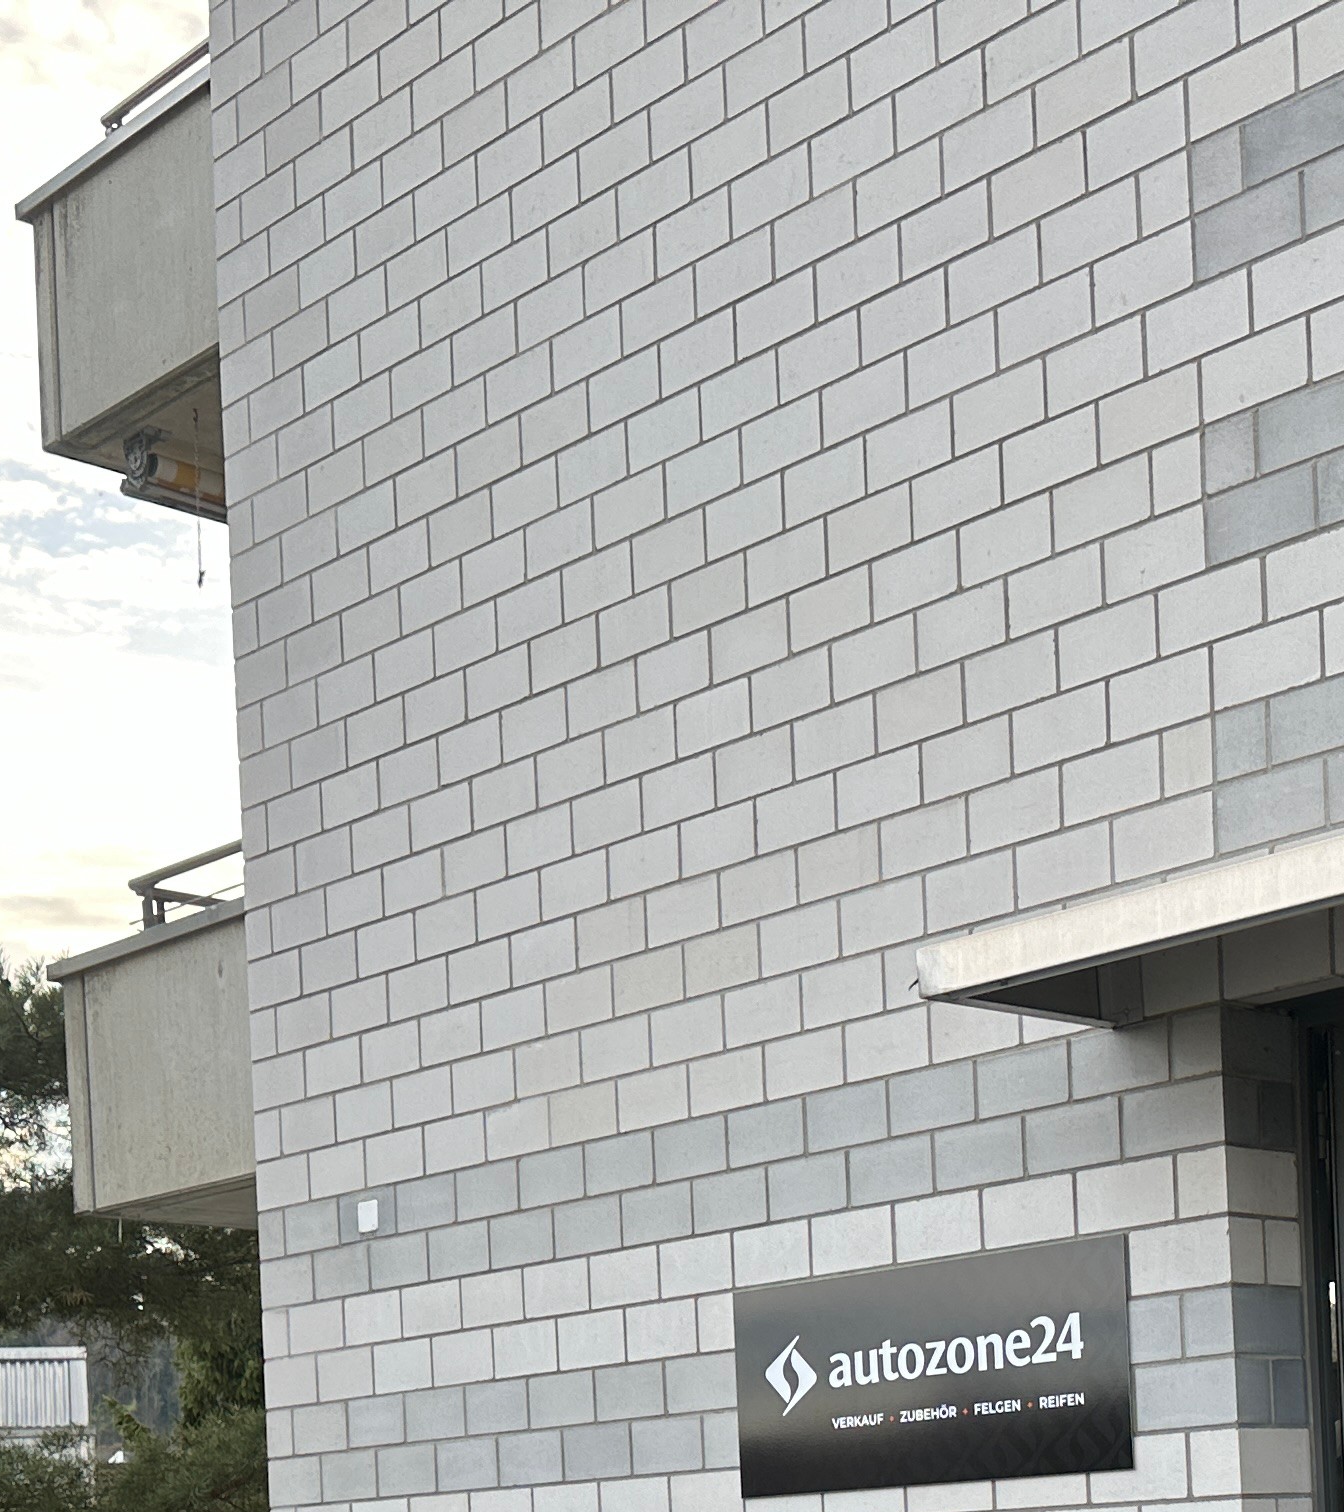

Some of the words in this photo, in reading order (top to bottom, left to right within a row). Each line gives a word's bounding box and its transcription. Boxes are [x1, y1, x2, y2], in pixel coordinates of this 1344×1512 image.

[828, 1312, 1084, 1389] autozone24
[831, 1411, 884, 1430] VERKAUF
[899, 1403, 957, 1424] ZUBEHÖR
[973, 1398, 1022, 1416] FELGEN
[1038, 1392, 1085, 1410] REIFEN
